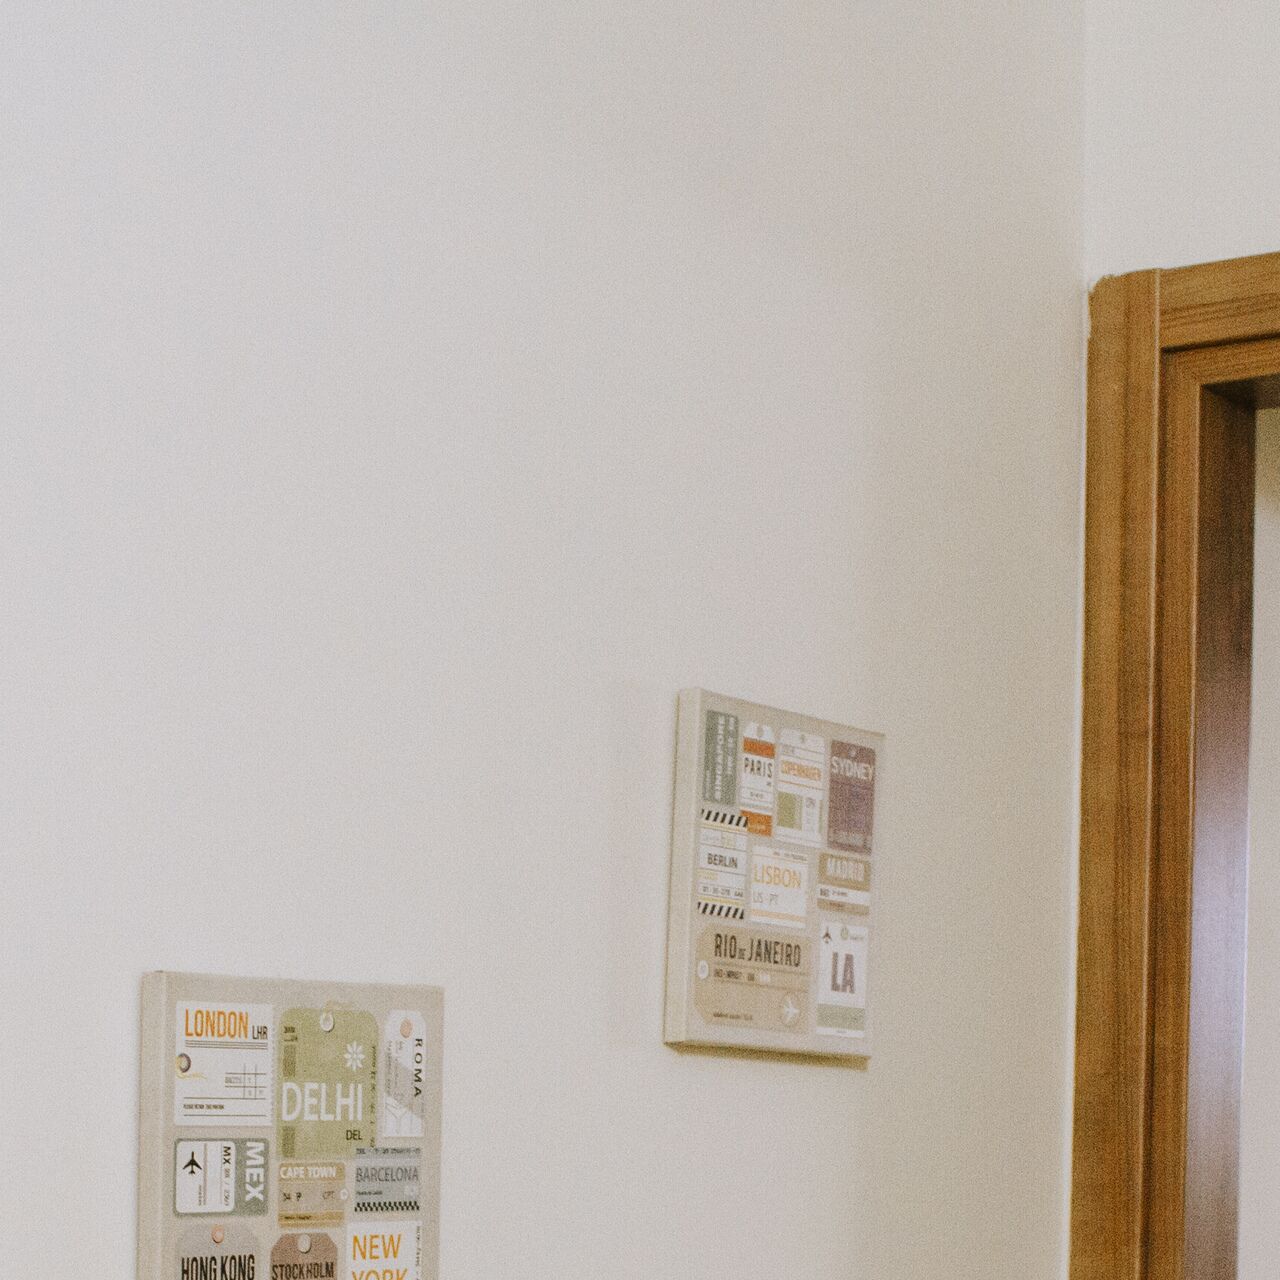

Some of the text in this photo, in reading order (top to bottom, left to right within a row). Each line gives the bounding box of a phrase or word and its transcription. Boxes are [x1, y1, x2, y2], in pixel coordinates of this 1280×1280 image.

[744, 757, 773, 779] PARIS
[831, 756, 873, 781] SYDNEY
[707, 852, 738, 869] BERLIN
[753, 863, 802, 889] LISBON
[714, 933, 737, 959] RIO
[747, 938, 801, 968] JANEIRO
[831, 951, 855, 994] LA
[184, 1008, 249, 1040] LONDON
[252, 1025, 268, 1040] LHR
[414, 1038, 423, 1098] ROMA
[281, 1081, 363, 1121] DELHI
[345, 1129, 363, 1141] DEL
[223, 1146, 232, 1165] MX
[245, 1141, 265, 1202] MEX
[280, 1166, 337, 1179] CAPE TOWN
[355, 1166, 419, 1182] BARCELONA
[352, 1233, 401, 1261] NEW
[271, 1261, 334, 1280] STOCKHOLM
